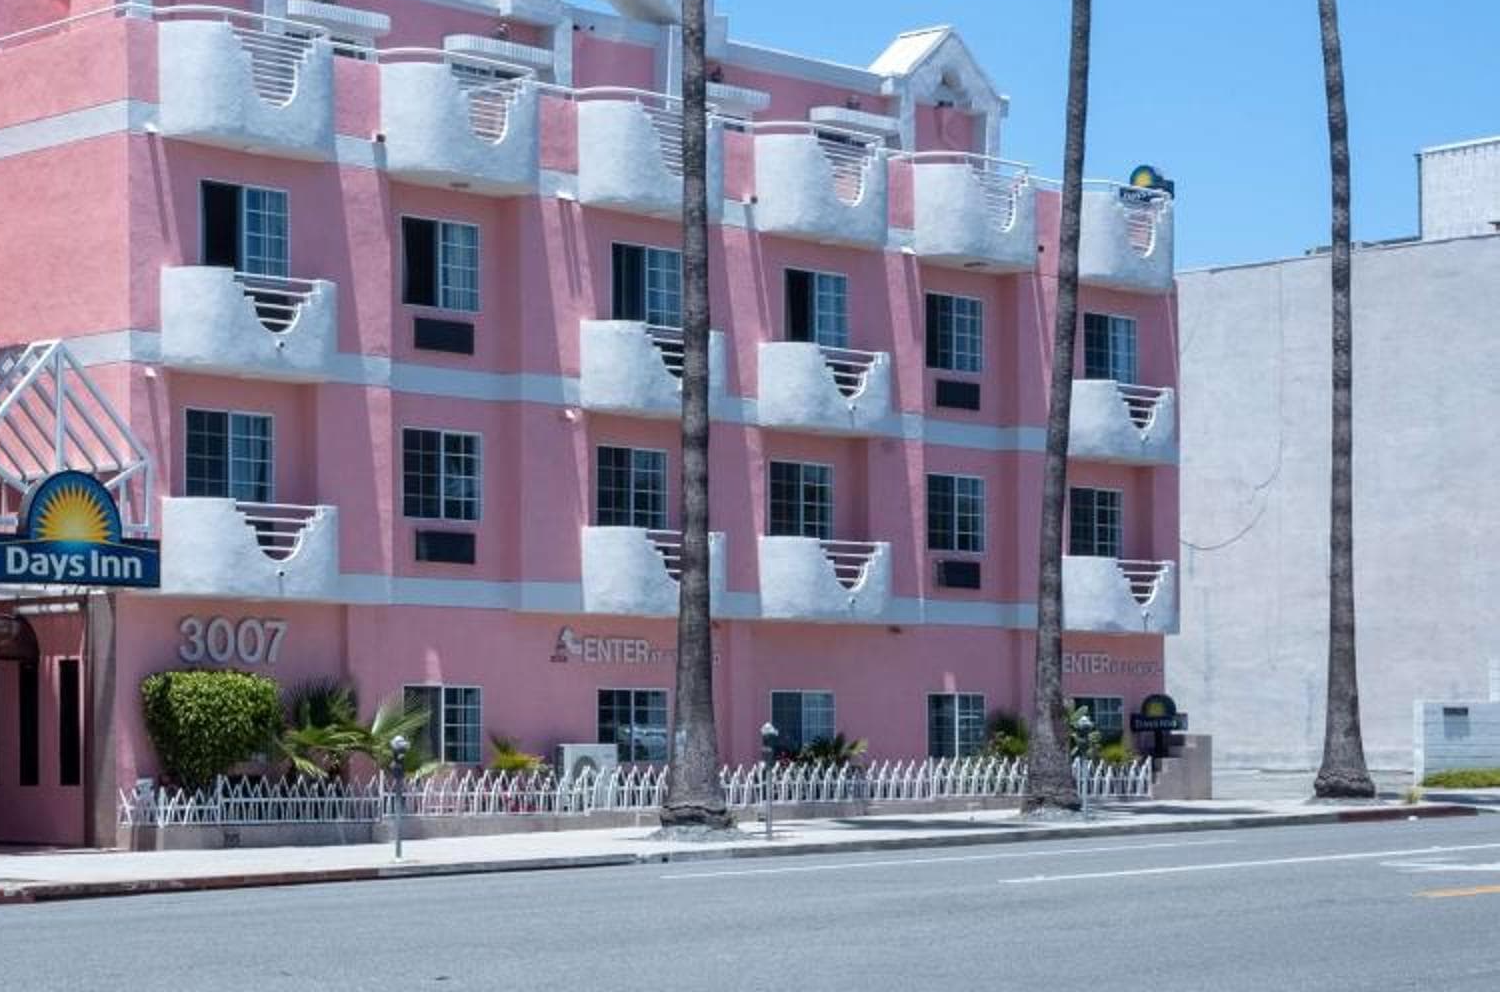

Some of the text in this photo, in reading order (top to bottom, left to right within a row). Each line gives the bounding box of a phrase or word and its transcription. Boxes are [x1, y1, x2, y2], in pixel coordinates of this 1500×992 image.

[6, 546, 142, 580] Days Inn
[178, 615, 288, 664] 3007
[583, 637, 650, 664] ENTER
[1062, 652, 1111, 674] ENTER
